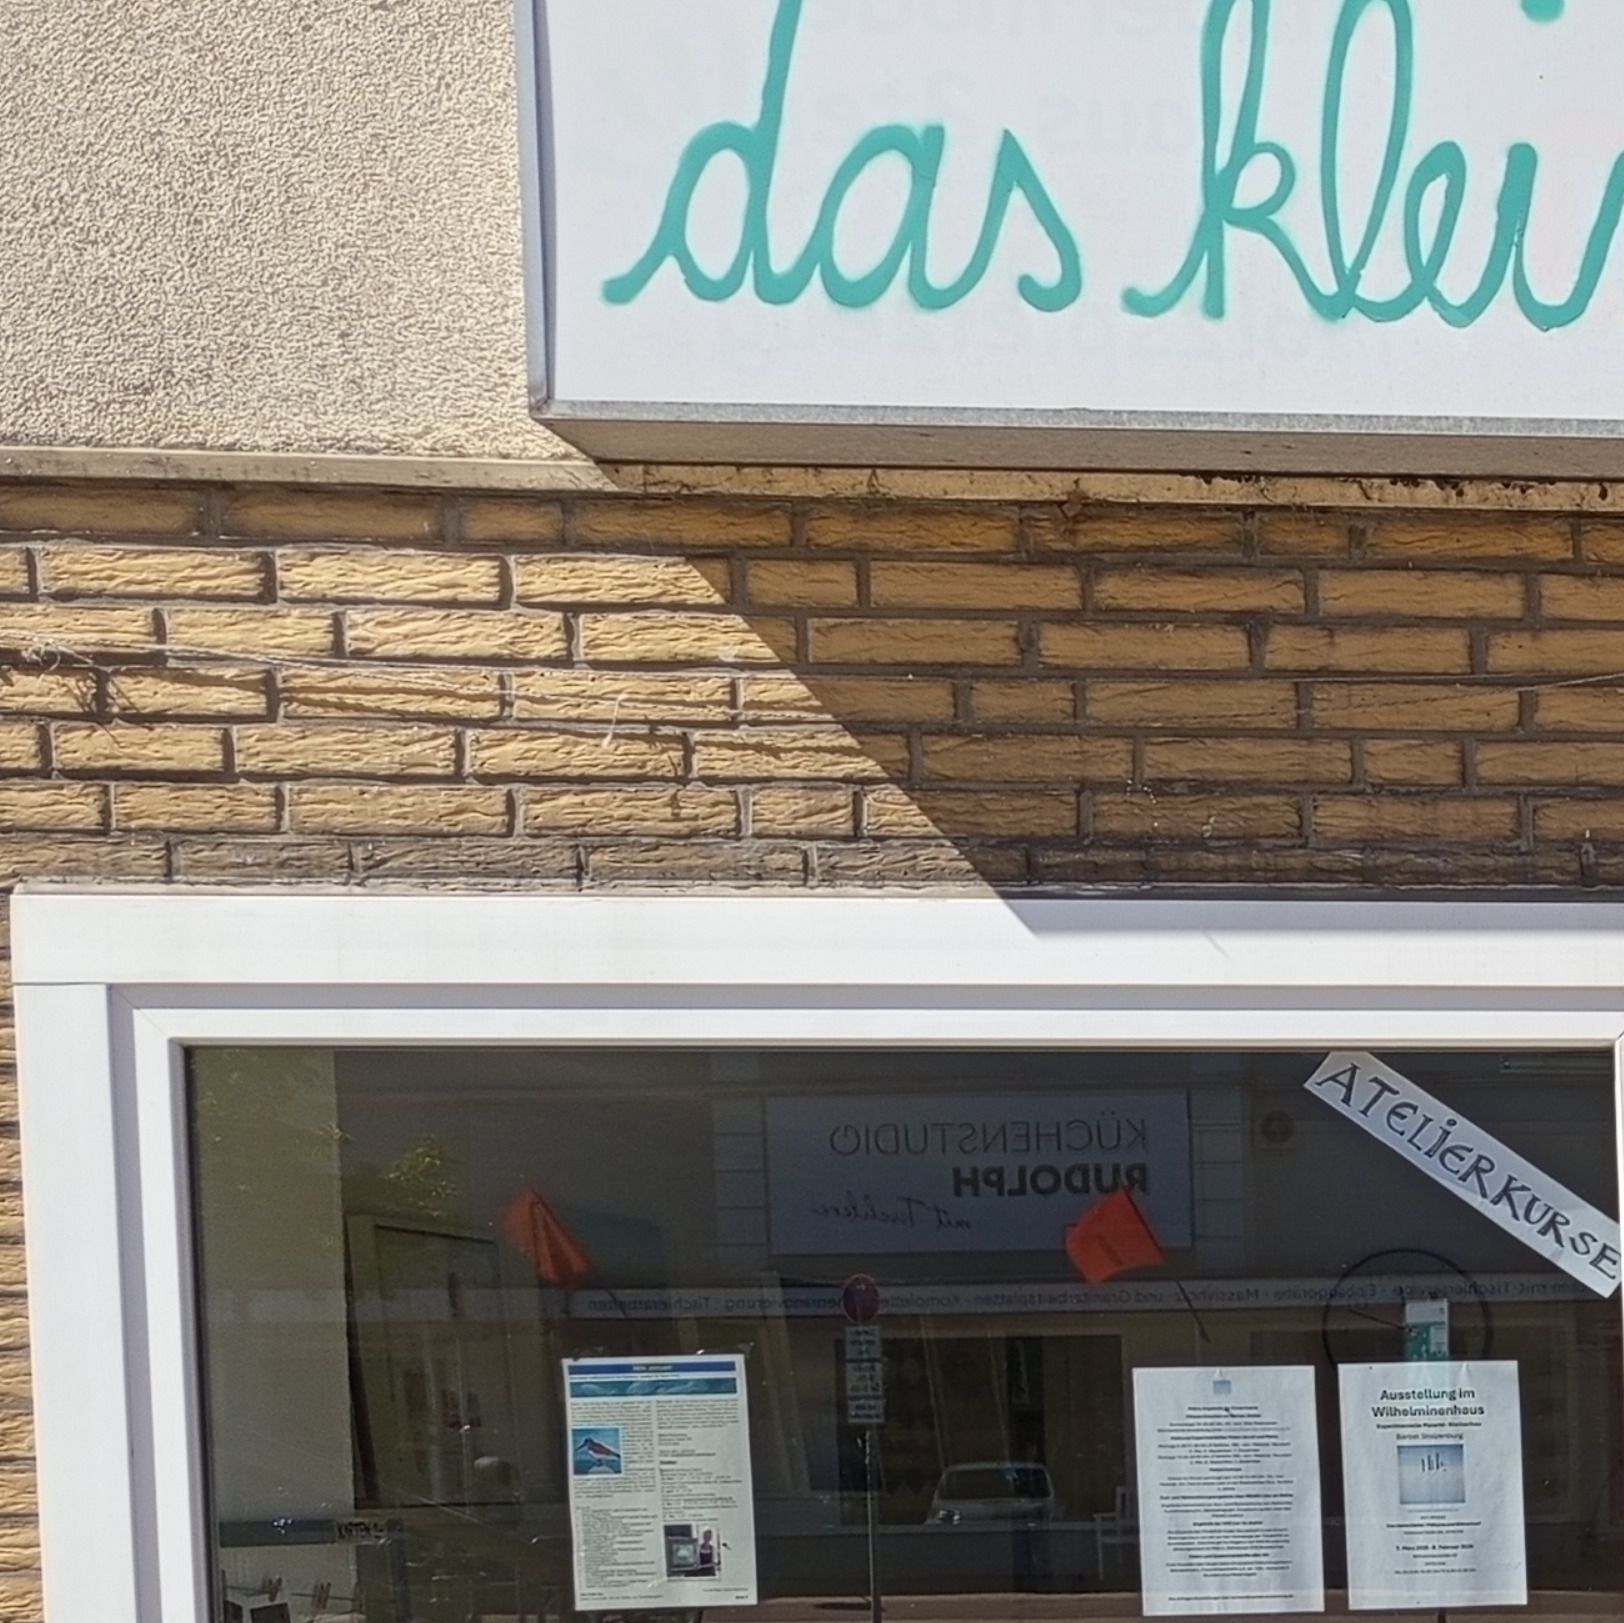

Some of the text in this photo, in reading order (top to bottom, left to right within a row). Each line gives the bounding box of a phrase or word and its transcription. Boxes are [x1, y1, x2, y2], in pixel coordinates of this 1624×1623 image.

[602, 0, 1084, 313] das
[1380, 1387, 1476, 1403] Ausstellung im
[1371, 1404, 1485, 1419] Wilhelminenhaus
